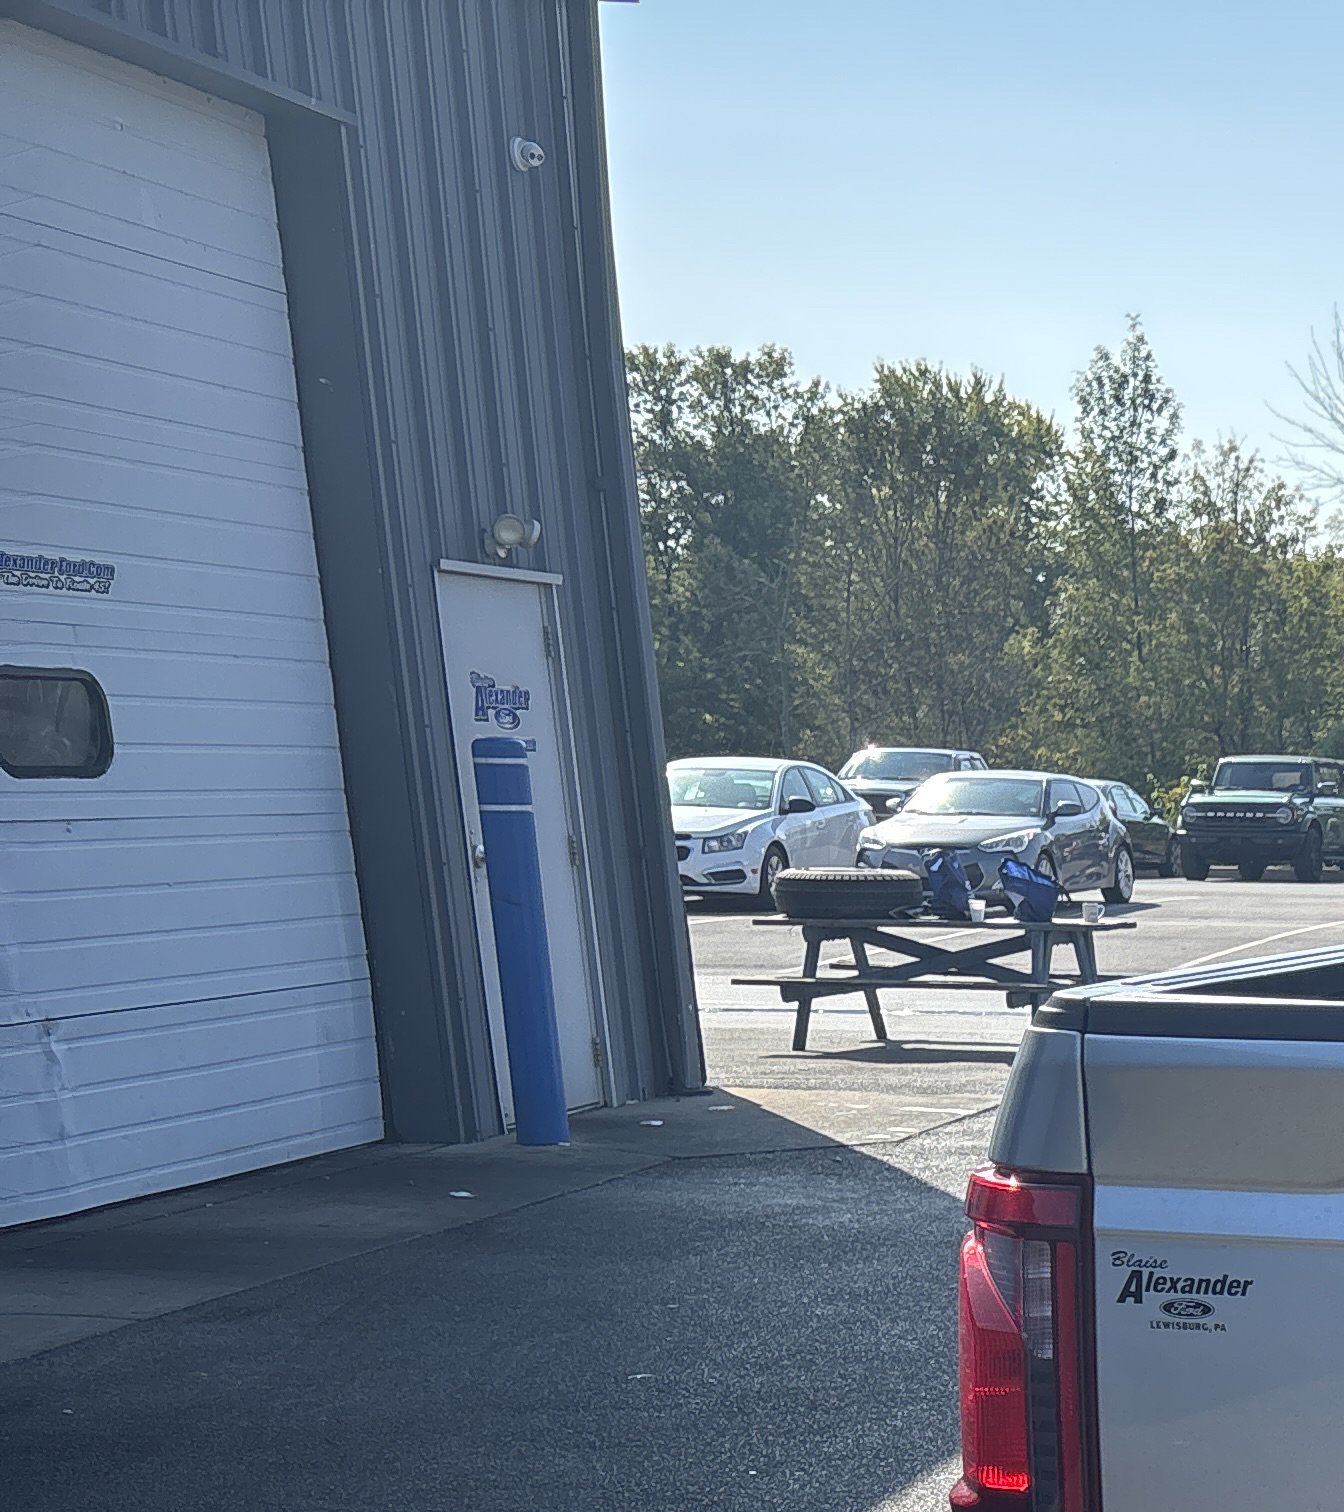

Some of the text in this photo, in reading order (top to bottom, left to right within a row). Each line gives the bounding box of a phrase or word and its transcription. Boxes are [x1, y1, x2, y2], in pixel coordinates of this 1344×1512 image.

[1110, 1250, 1169, 1269] Blaise
[1116, 1269, 1254, 1304] Alexander
[1170, 1301, 1204, 1316] Ford
[1214, 1323, 1227, 1332] PA
